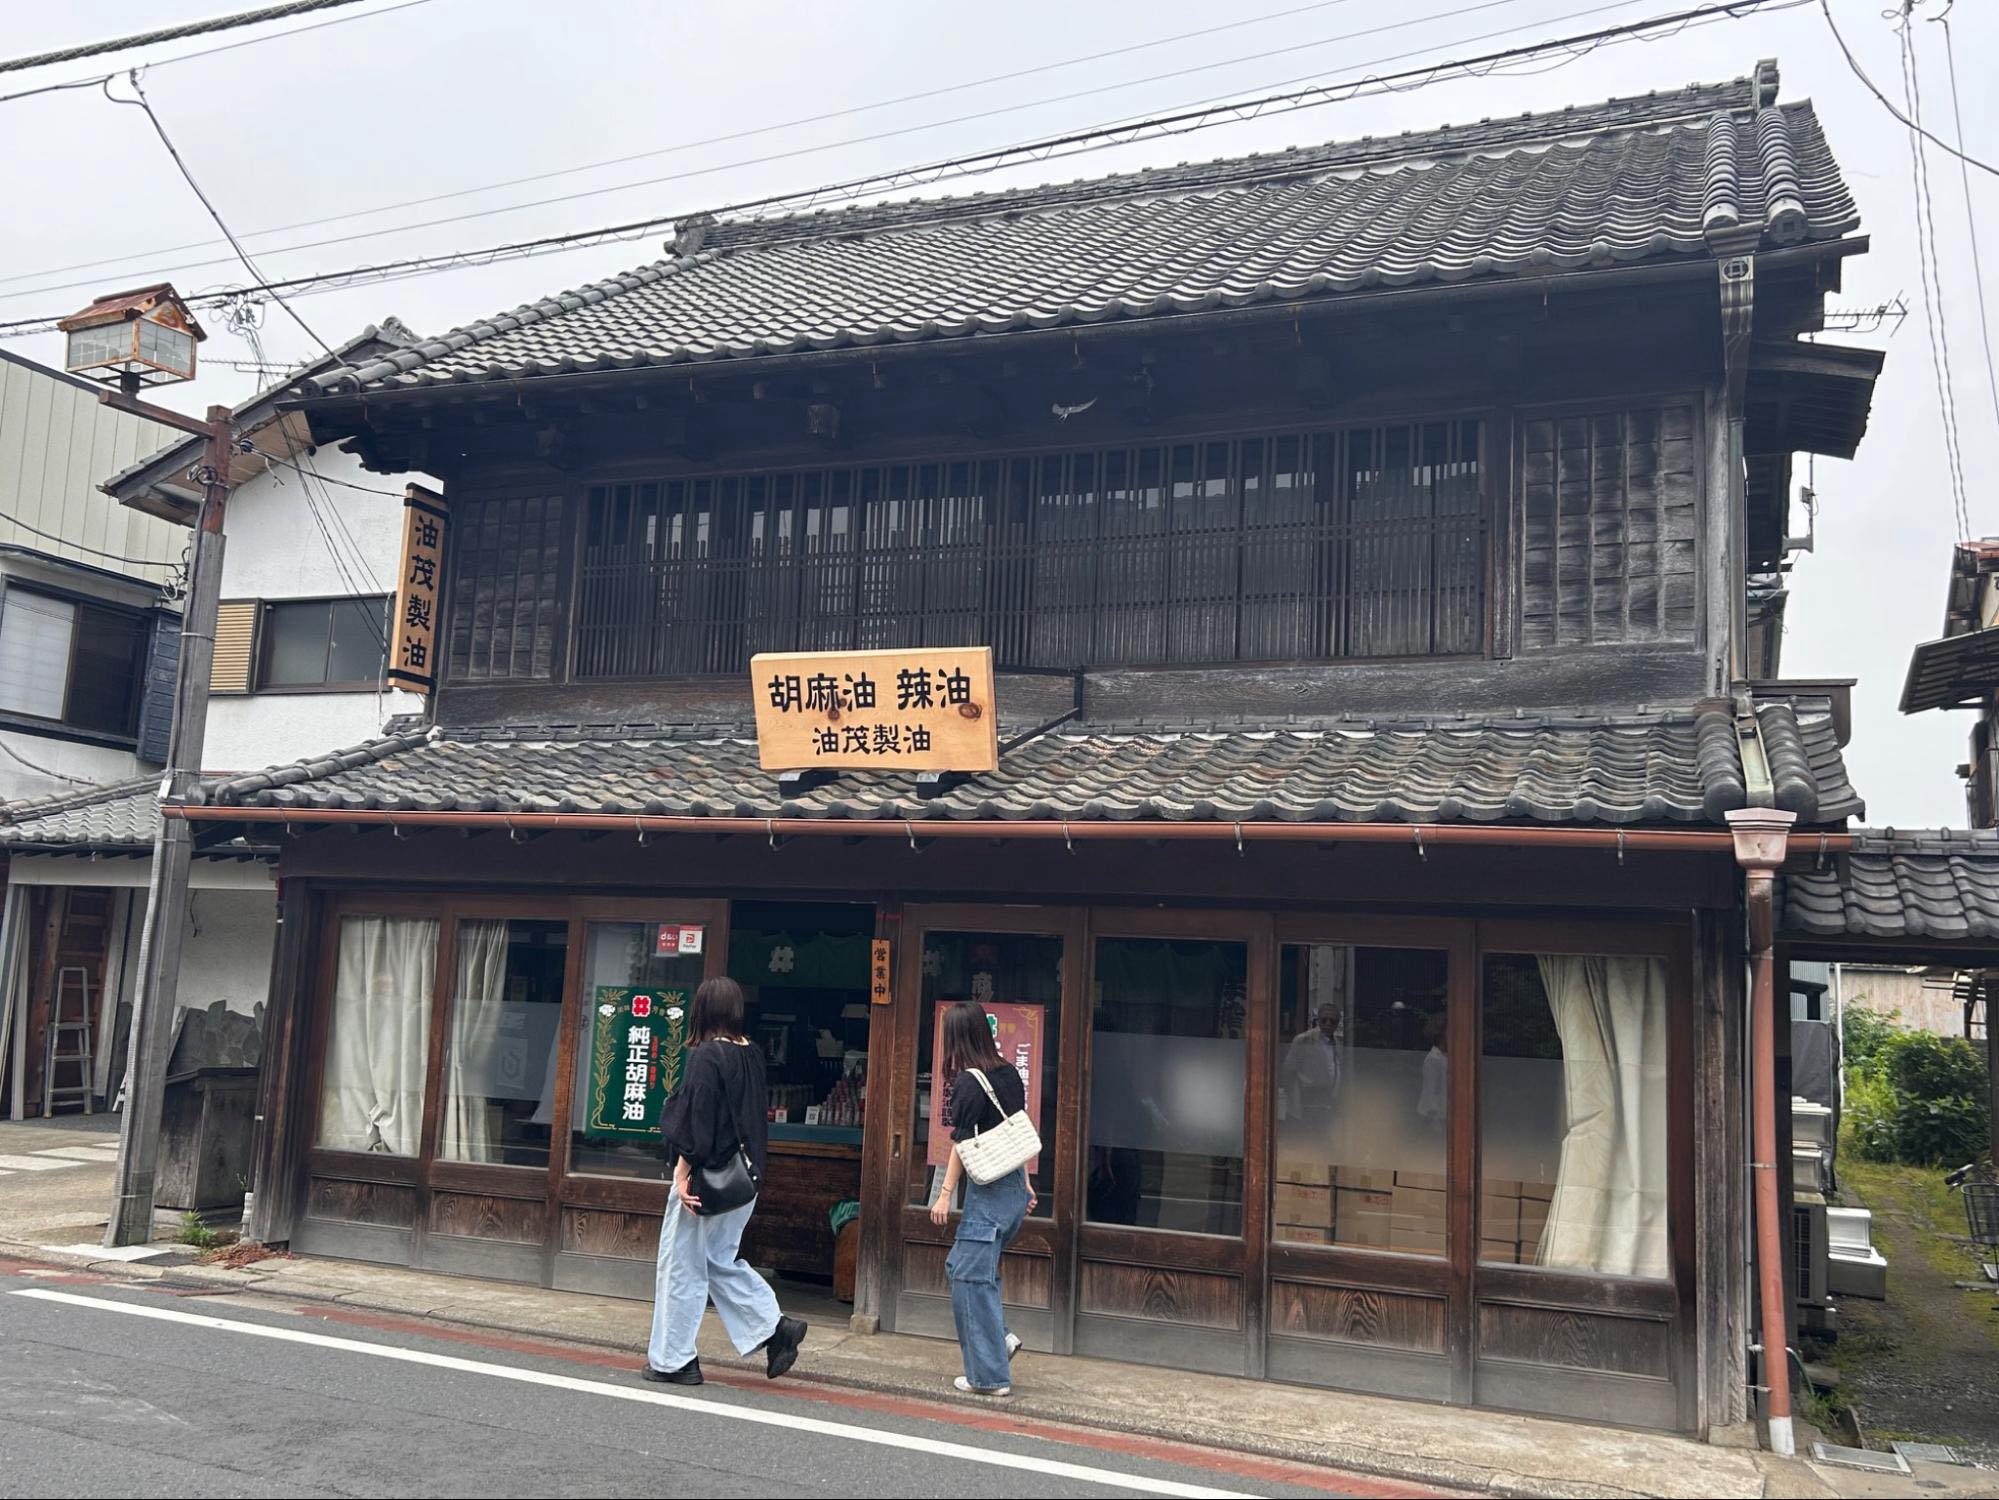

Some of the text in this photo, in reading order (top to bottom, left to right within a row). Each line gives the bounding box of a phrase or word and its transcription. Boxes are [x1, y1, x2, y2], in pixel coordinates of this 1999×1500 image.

[403, 515, 439, 669] 油茂製油
[768, 667, 971, 713] 胡麻油 辣油
[811, 723, 932, 755] 油茂製油
[874, 947, 887, 998] 営業中
[622, 1025, 651, 1121] 純正胡麻油
